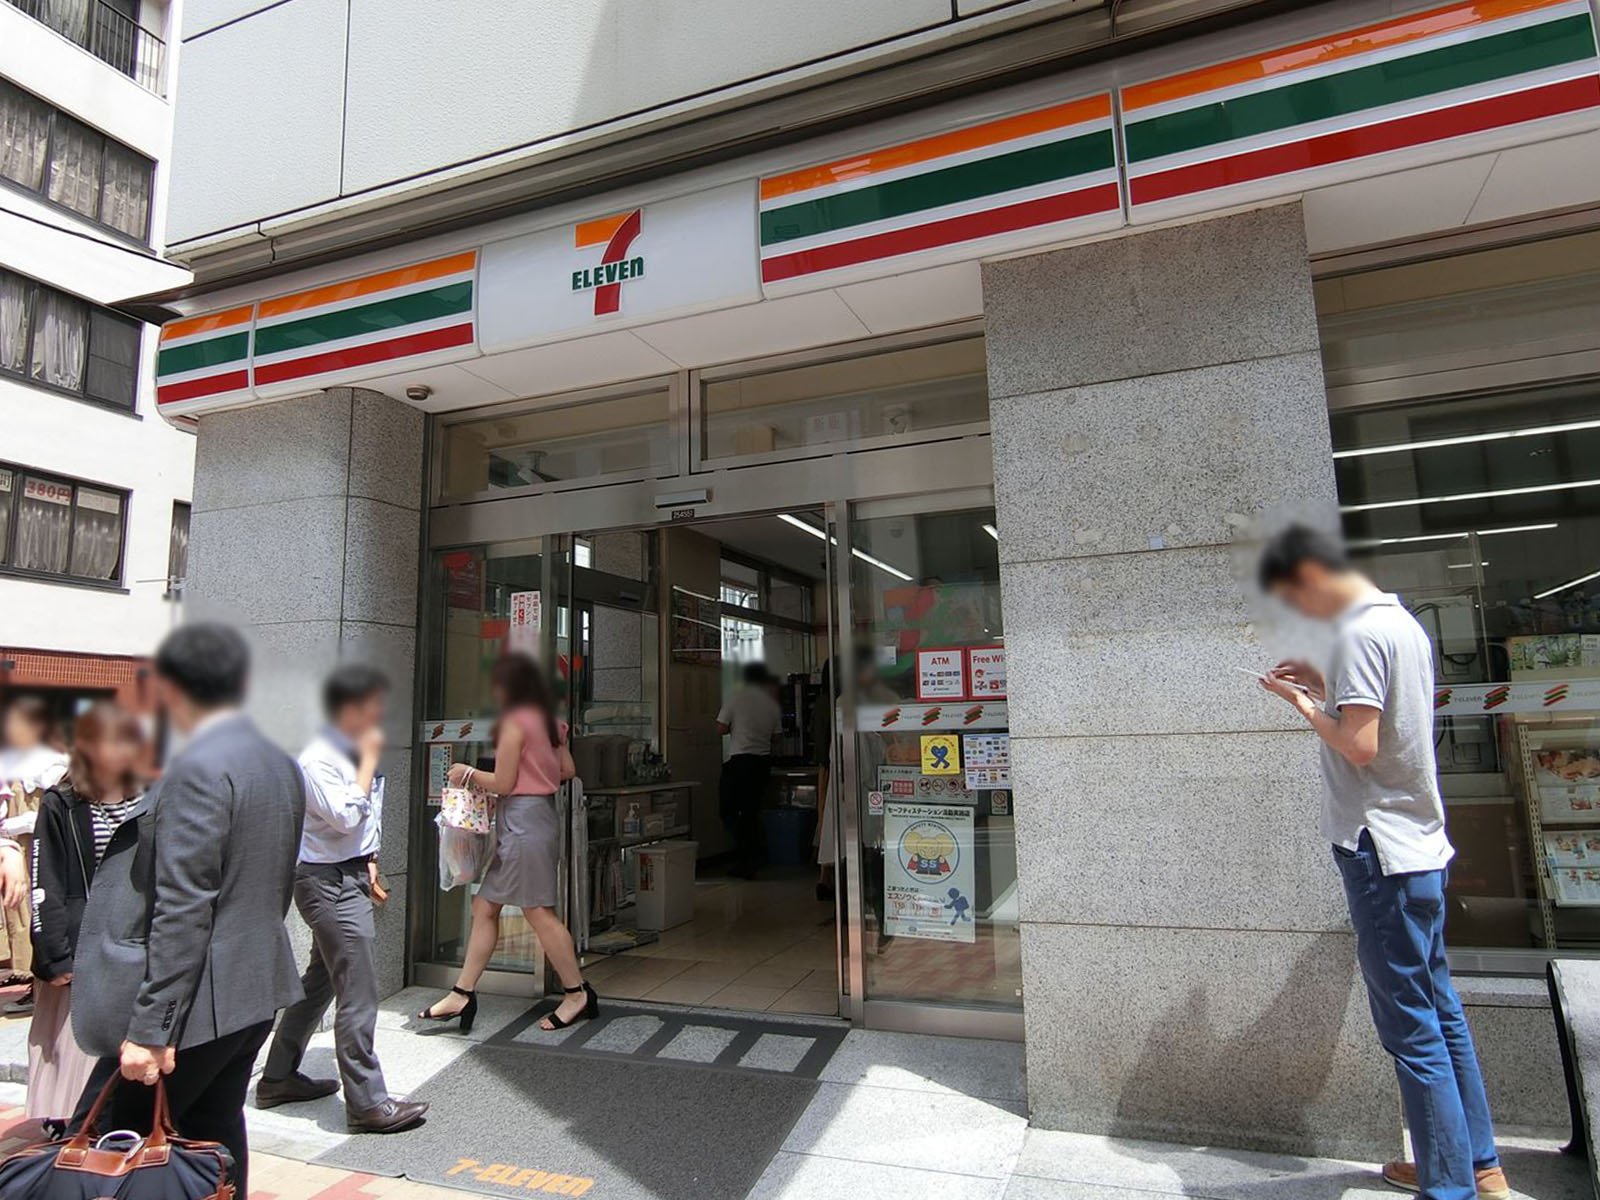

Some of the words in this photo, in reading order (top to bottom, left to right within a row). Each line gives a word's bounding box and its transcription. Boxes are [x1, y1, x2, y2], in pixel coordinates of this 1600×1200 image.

[930, 656, 950, 665] ATM
[972, 655, 990, 664] Free
[920, 859, 937, 869] SS
